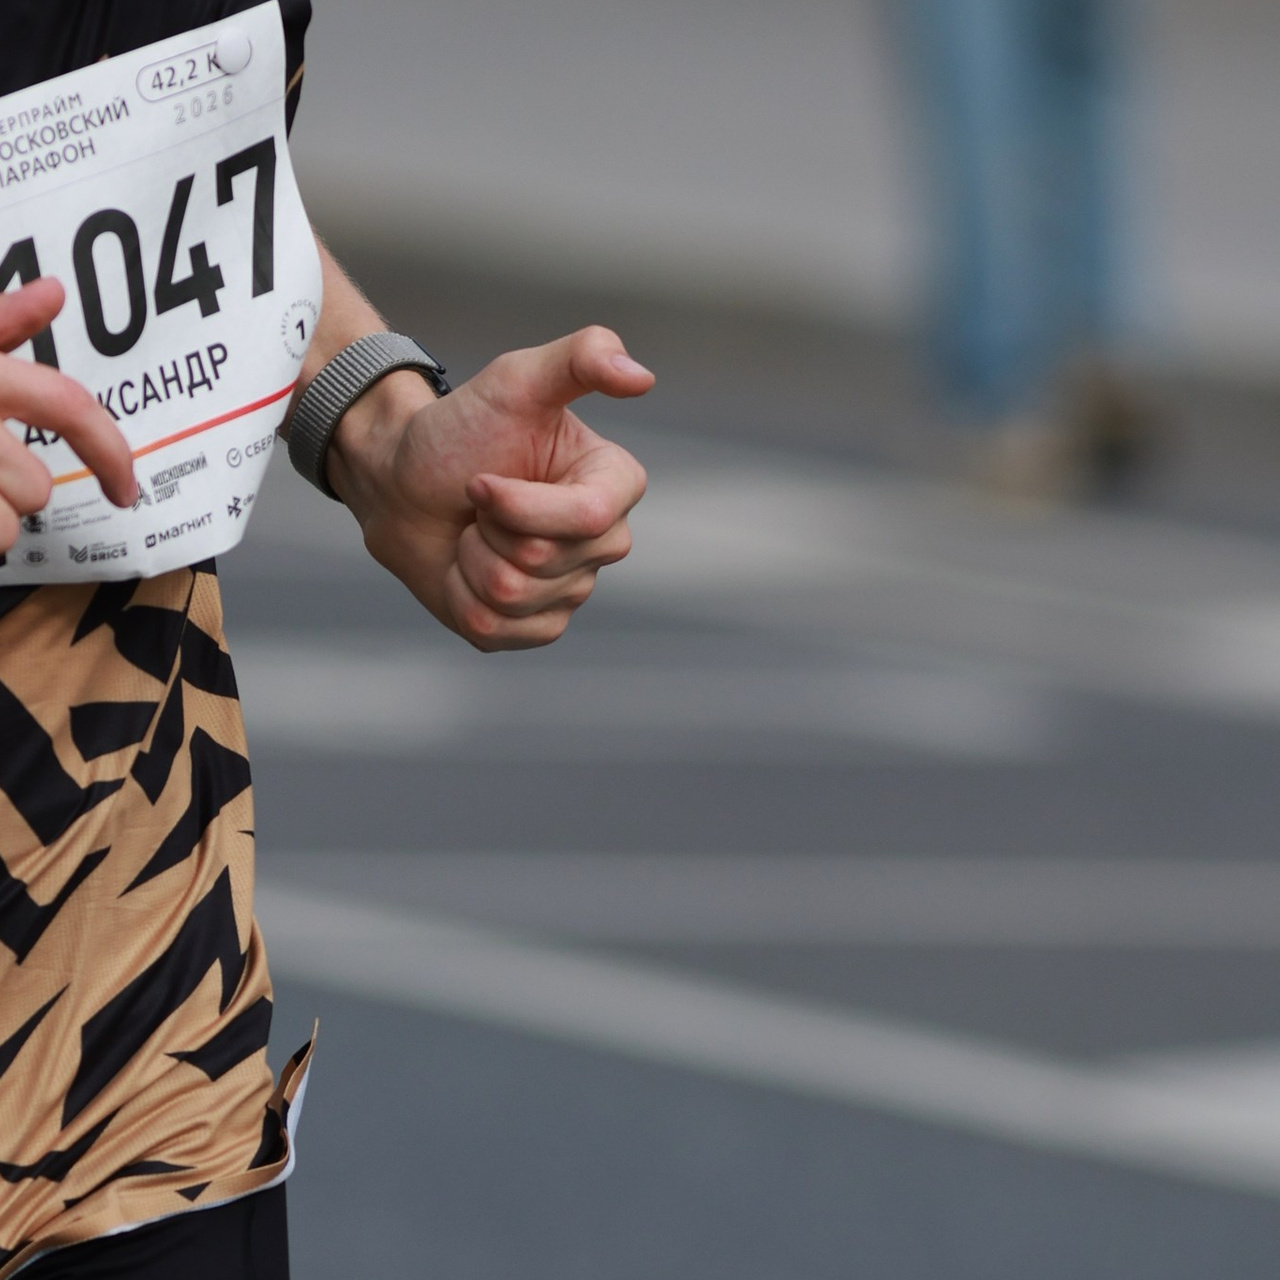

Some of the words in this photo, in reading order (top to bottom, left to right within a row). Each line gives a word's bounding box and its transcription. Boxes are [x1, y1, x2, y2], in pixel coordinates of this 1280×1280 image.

[151, 58, 198, 91] 42,2
[173, 83, 233, 125] 2026
[23, 342, 229, 447] АКСАНДР
[149, 451, 208, 488] МОСКОВСКИЙ
[153, 481, 180, 504] СПОРТ
